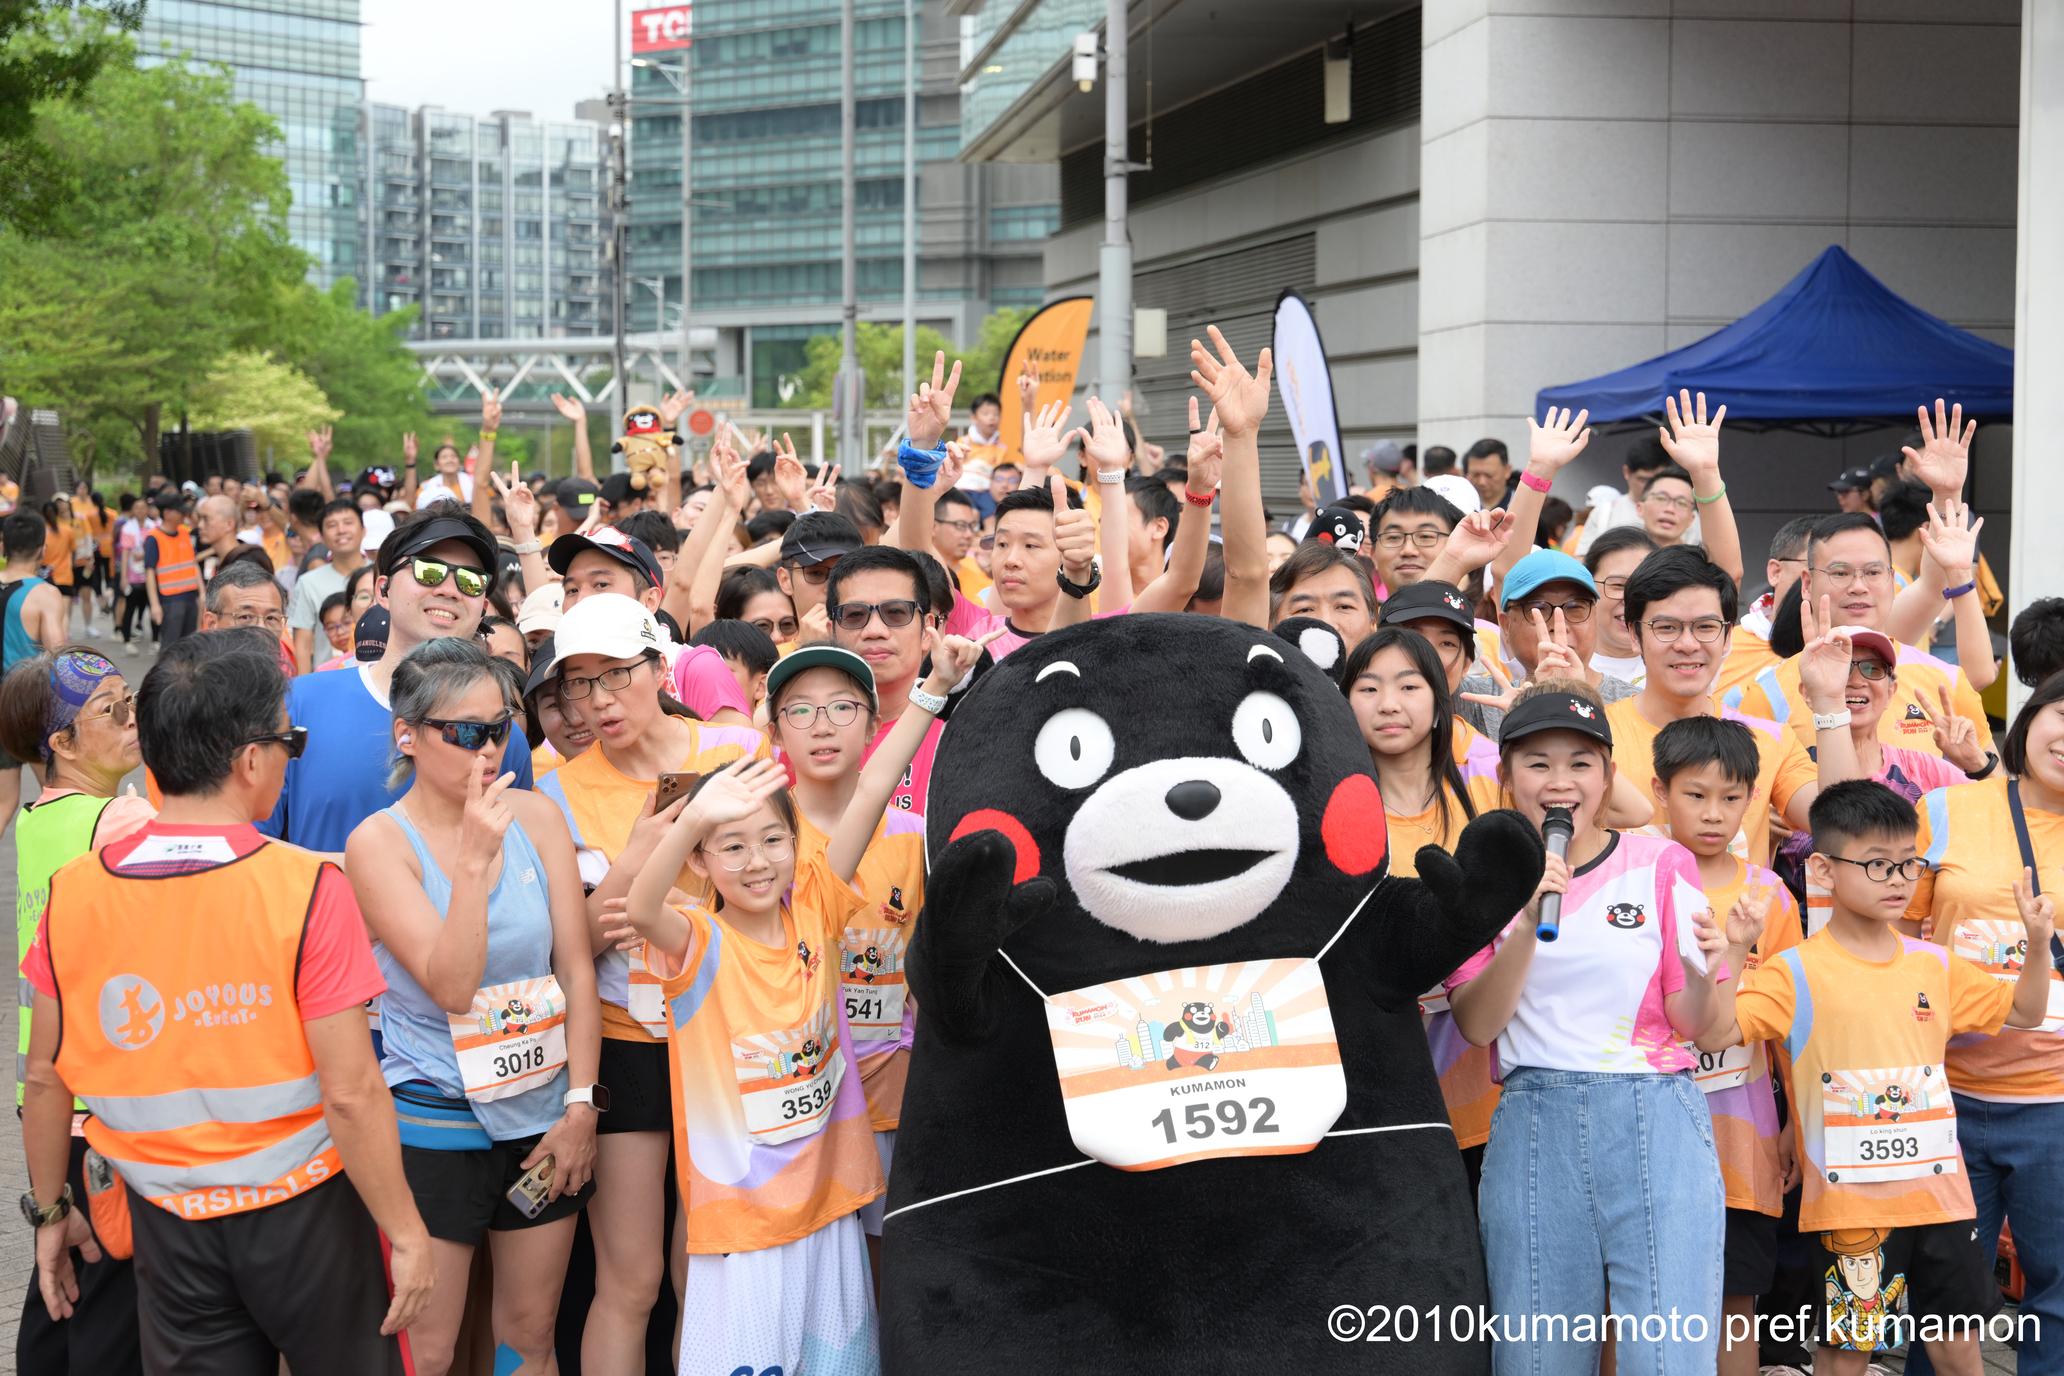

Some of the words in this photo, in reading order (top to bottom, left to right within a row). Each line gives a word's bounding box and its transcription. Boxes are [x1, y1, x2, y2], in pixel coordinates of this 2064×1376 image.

[1027, 348, 1071, 362] Water
[174, 983, 273, 1021] JOYOUS
[1194, 1041, 1210, 1049] 312
[493, 1046, 544, 1078] 3018
[784, 1085, 804, 1095] WONG
[1170, 1078, 1247, 1096] KUMAMON
[781, 1080, 832, 1120] 3539
[1151, 1097, 1280, 1144] 1592
[1859, 1137, 1918, 1161] 3593
